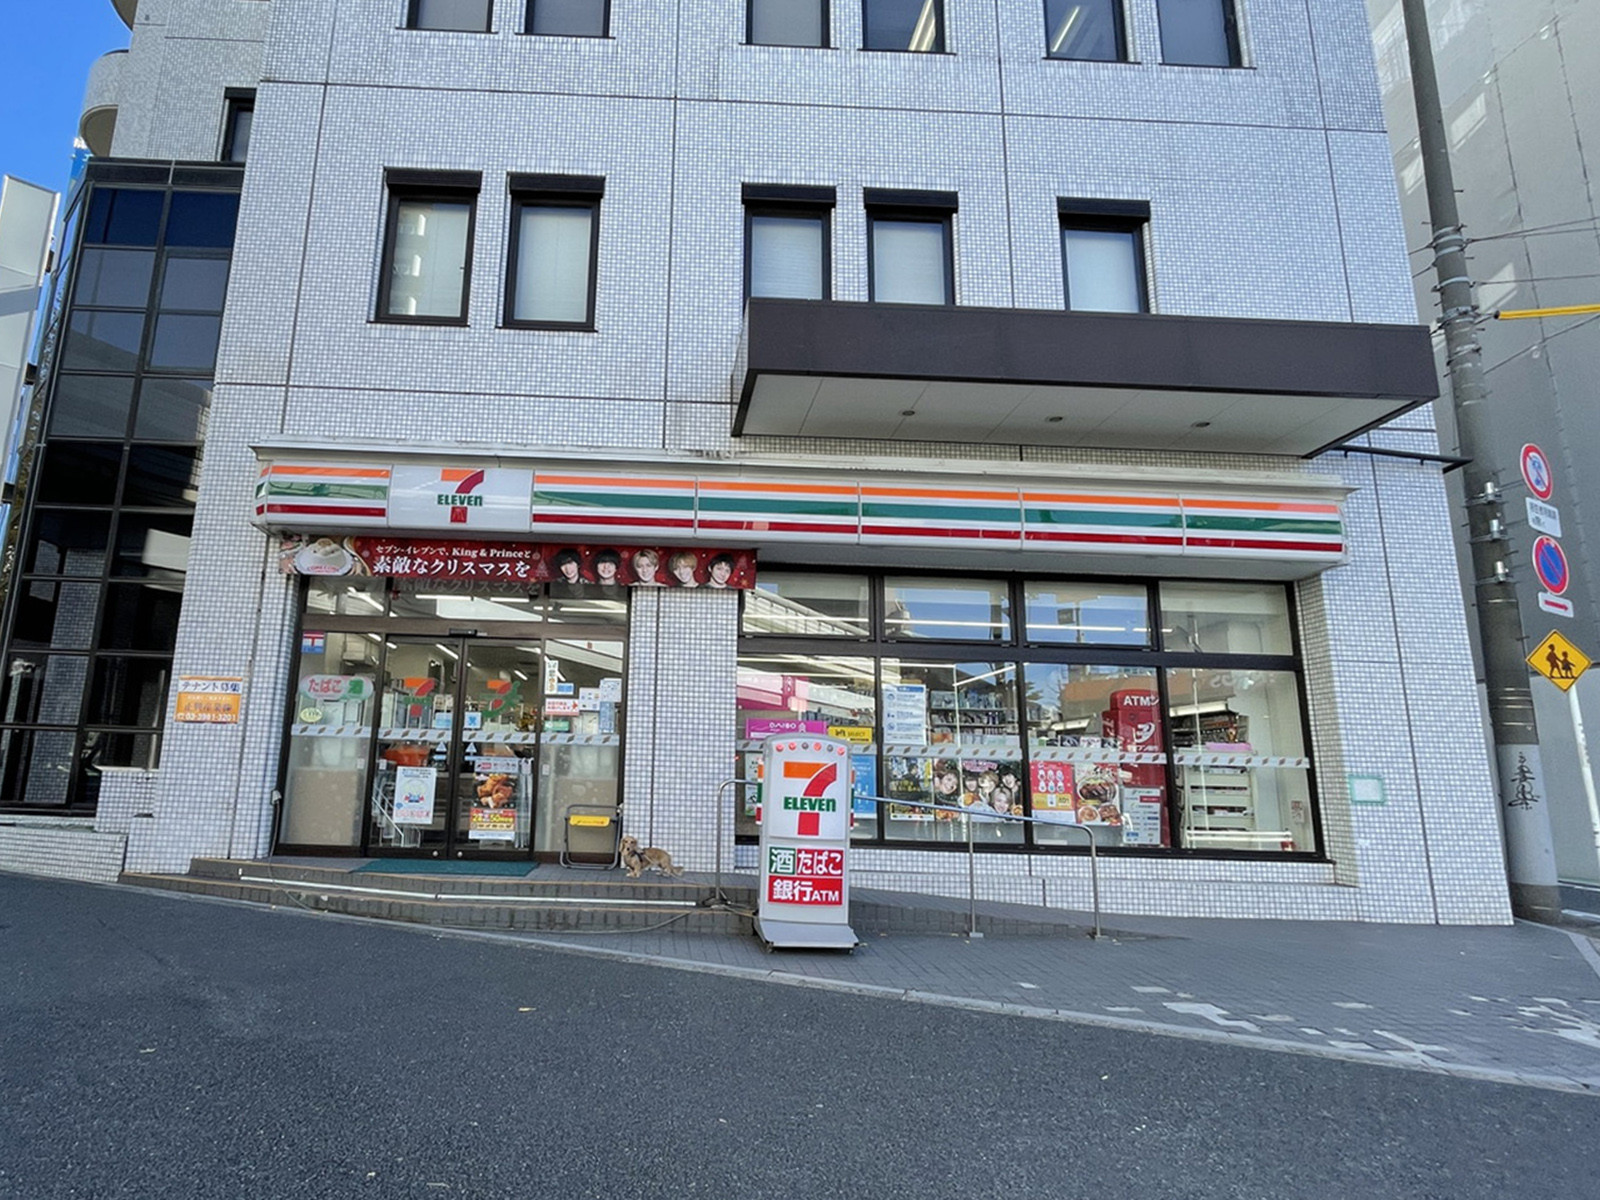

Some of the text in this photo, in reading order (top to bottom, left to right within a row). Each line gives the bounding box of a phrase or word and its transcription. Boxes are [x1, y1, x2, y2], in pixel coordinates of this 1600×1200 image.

[437, 494, 483, 506] ELEVEN
[452, 547, 477, 558] King
[479, 549, 488, 557] &
[489, 549, 531, 559] Princeと
[373, 555, 531, 578] 素敵なクリスマスを
[308, 678, 342, 693] たばこ
[1123, 695, 1149, 706] ATM
[783, 796, 836, 812] ELEVEN
[770, 849, 843, 876] 酒 たばこ
